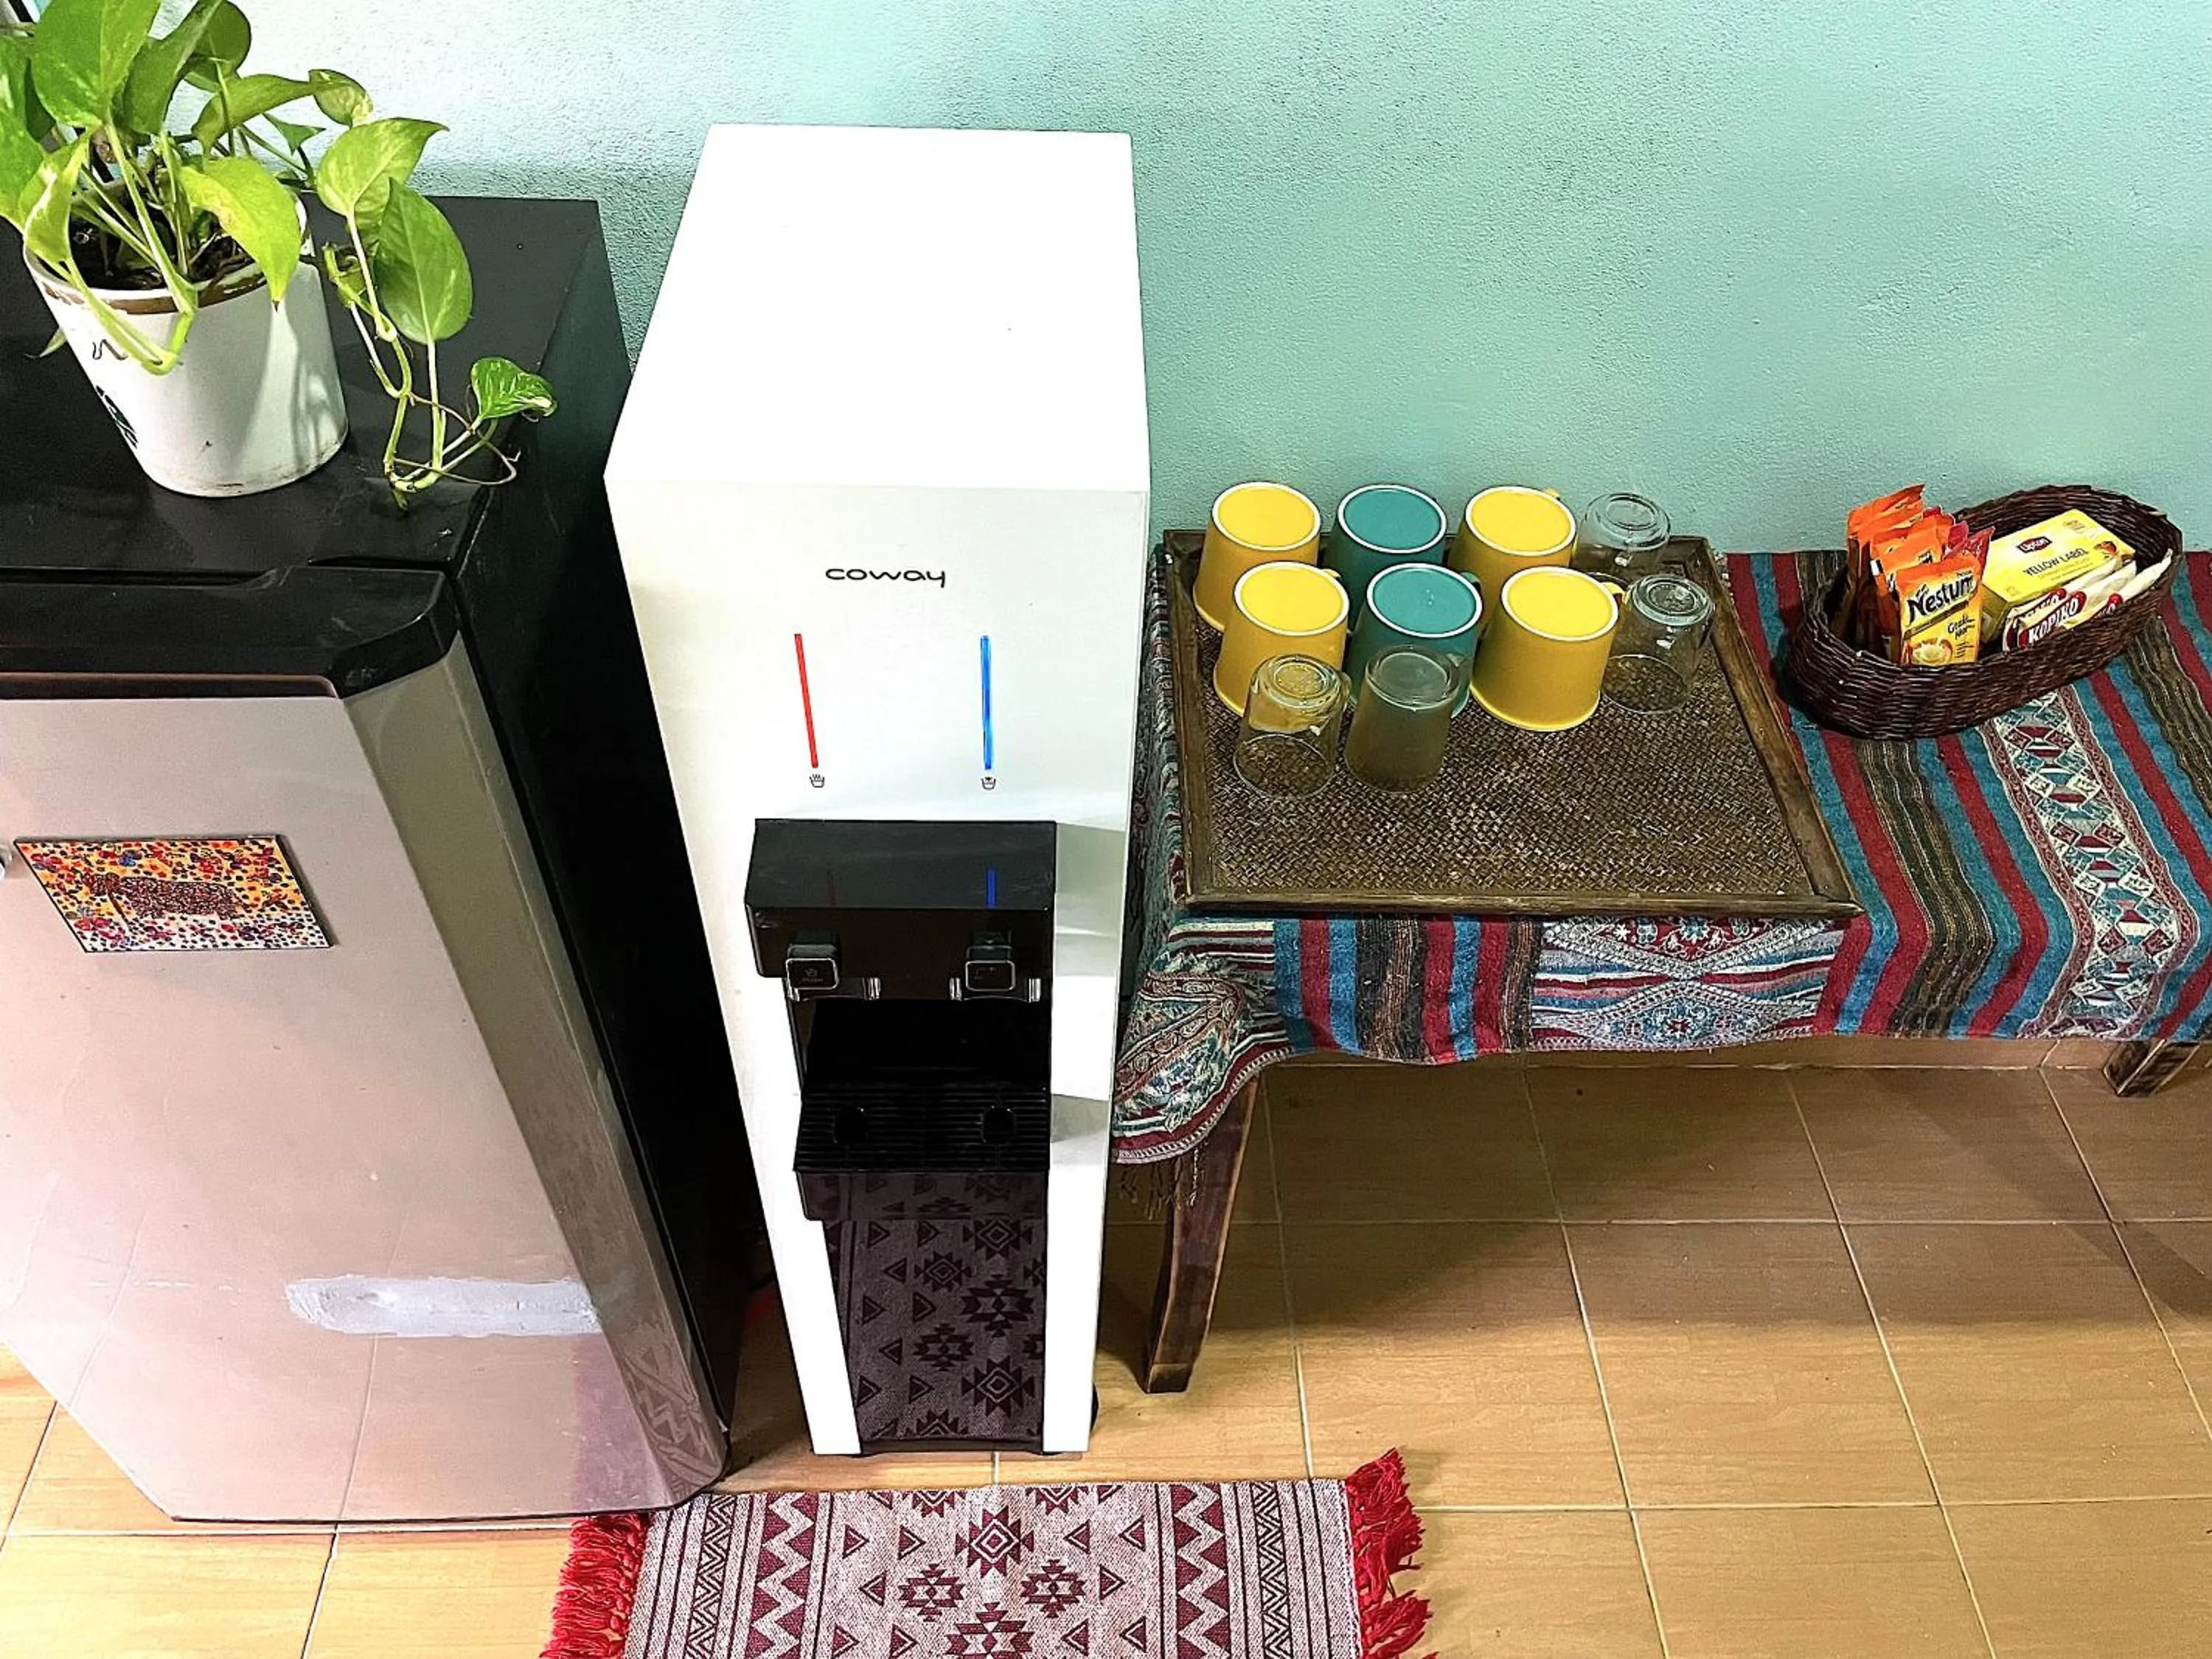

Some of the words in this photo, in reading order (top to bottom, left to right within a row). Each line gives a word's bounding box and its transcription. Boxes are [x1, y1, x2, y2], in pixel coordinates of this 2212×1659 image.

[2023, 557, 2059, 575] YELLOW
[2060, 548, 2089, 563] LABEL
[825, 568, 945, 588] coway
[2028, 598, 2079, 644] KOPIKO
